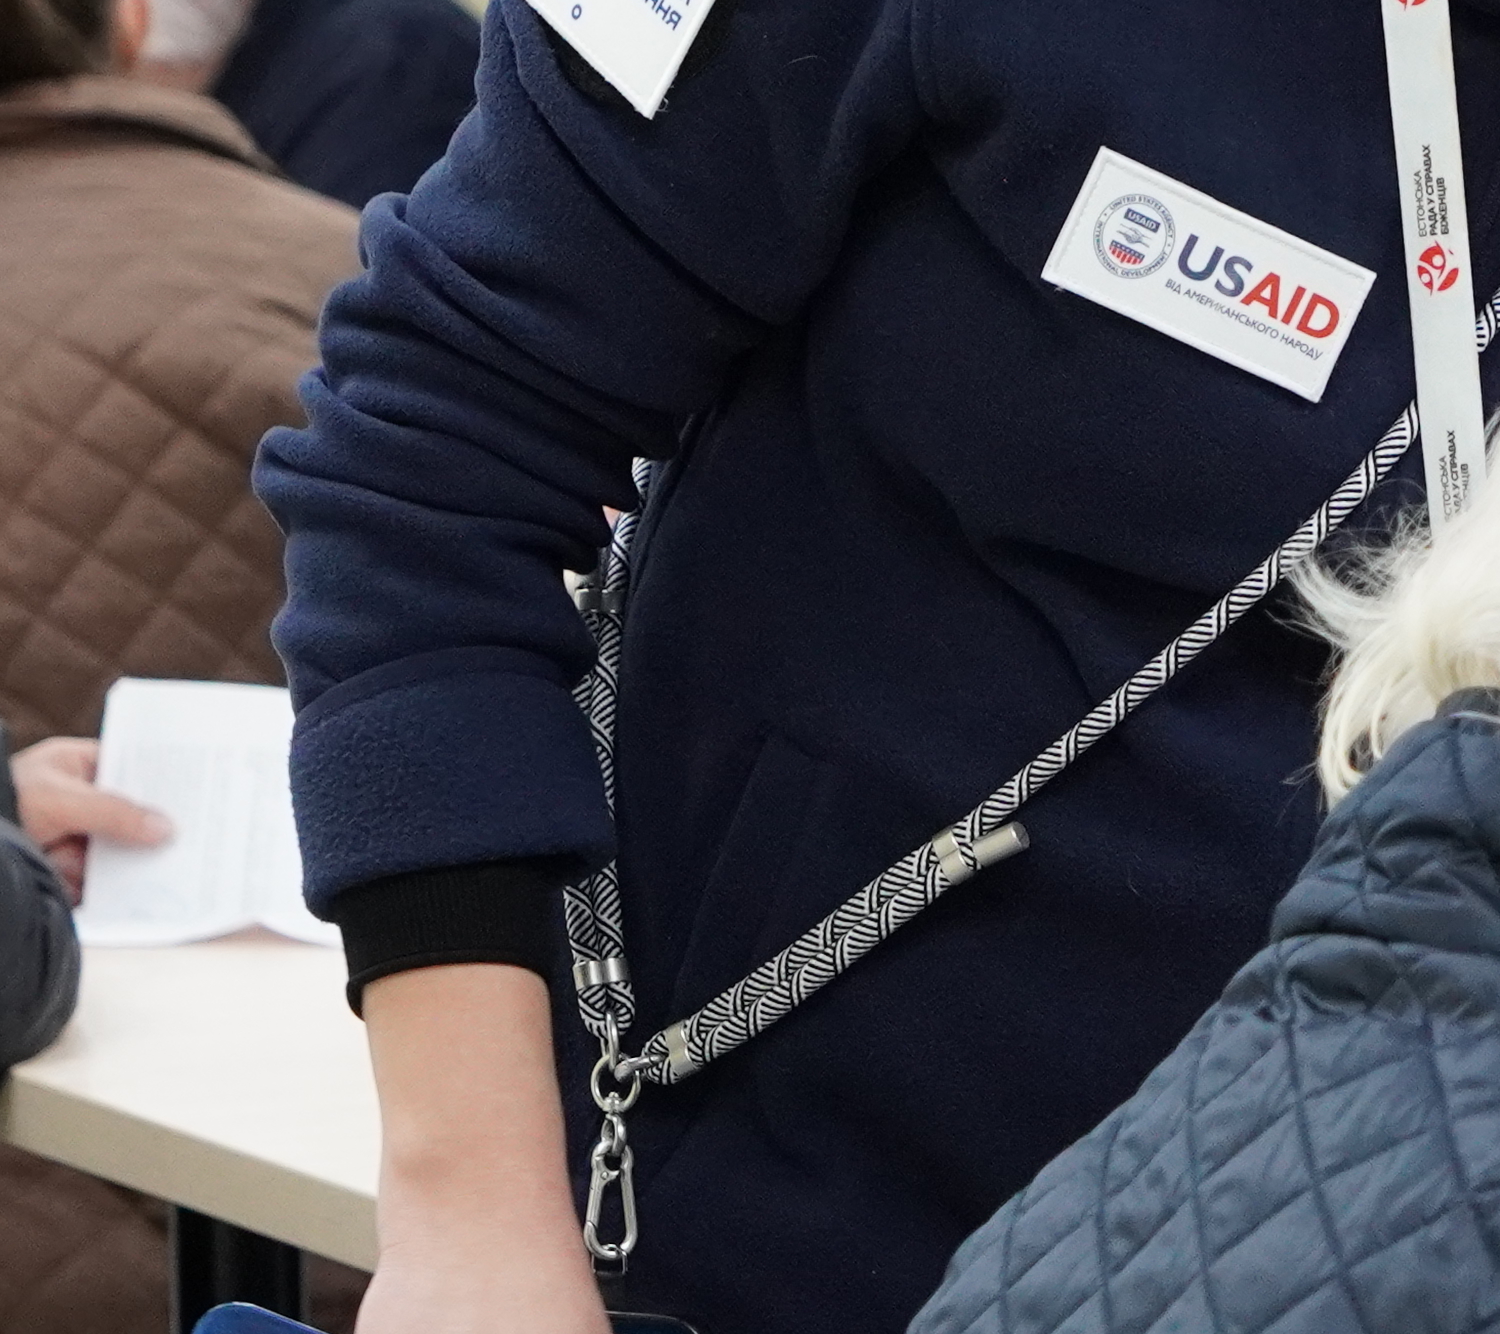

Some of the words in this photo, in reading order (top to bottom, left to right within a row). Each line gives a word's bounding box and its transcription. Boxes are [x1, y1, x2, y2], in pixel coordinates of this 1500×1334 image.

[1127, 210, 1157, 230] USAID
[1413, 170, 1427, 237] ЕСТОНСЬКА
[1427, 197, 1435, 205] У
[1428, 206, 1438, 236] РАДА
[1177, 233, 1340, 339] USAID
[1165, 278, 1181, 295] ВІД
[1184, 288, 1279, 339] АМЕРИКАНСЬКОГО
[1280, 333, 1323, 361] НАРОДУ
